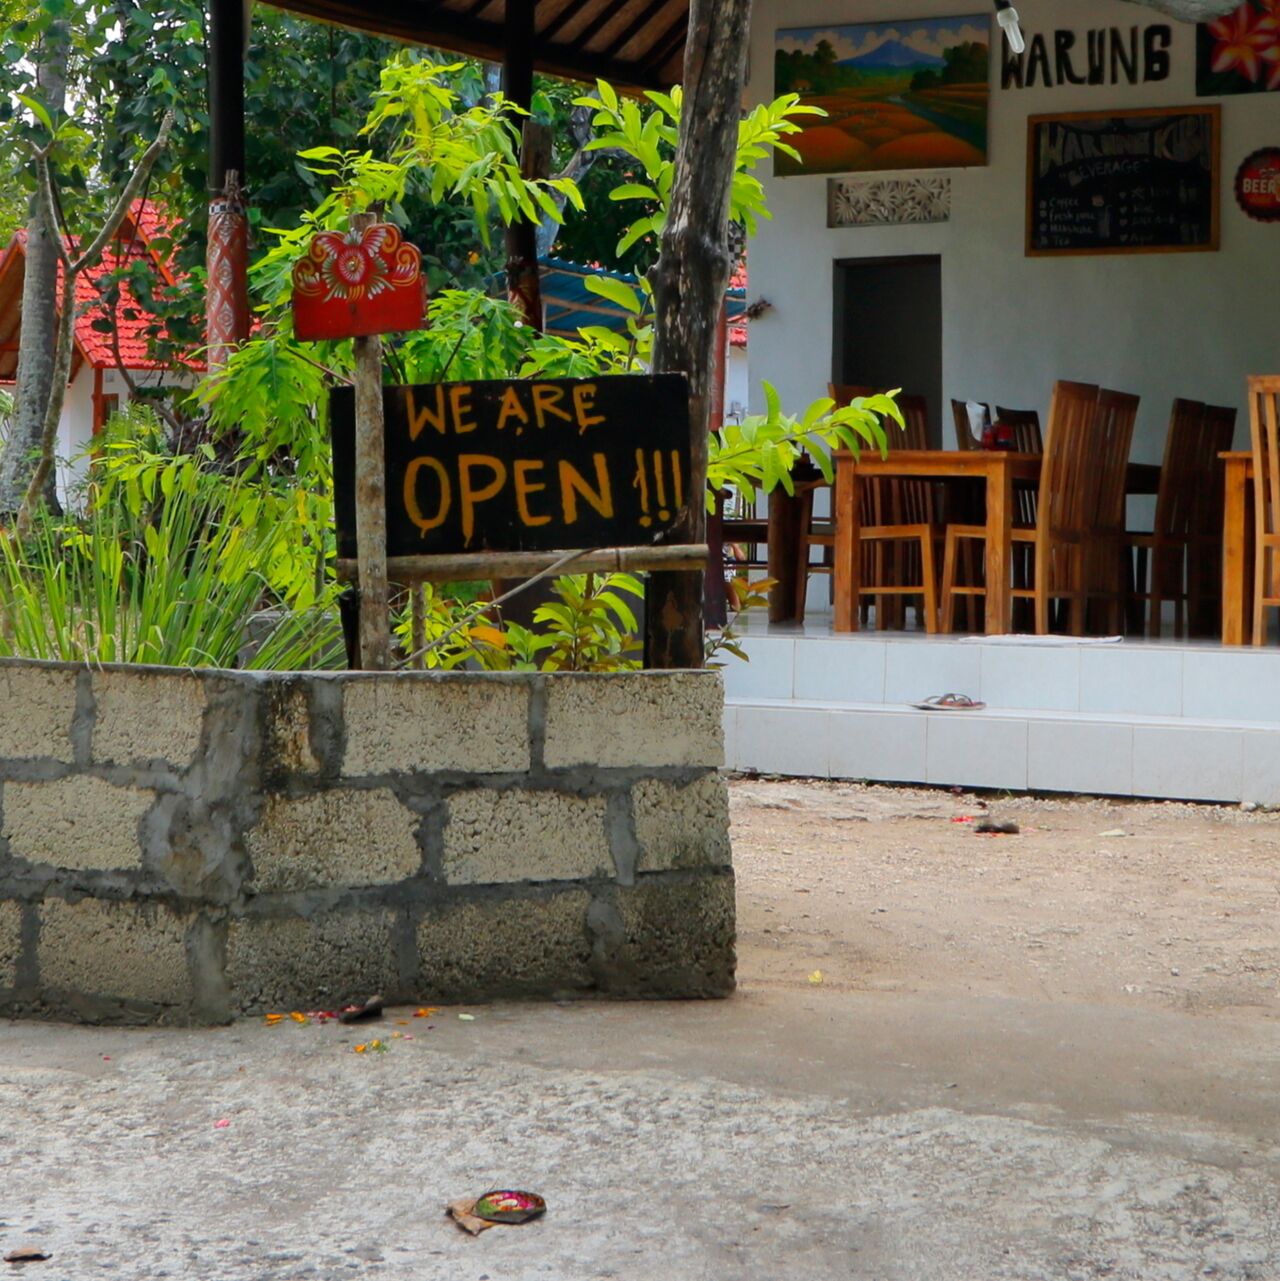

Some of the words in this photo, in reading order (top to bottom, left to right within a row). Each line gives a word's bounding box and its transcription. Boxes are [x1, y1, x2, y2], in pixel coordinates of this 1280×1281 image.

[1001, 24, 1172, 90] WARUNG
[1243, 178, 1277, 194] BEER
[406, 385, 478, 441] WE
[497, 383, 605, 436] ARE
[402, 452, 614, 547] OPEN
